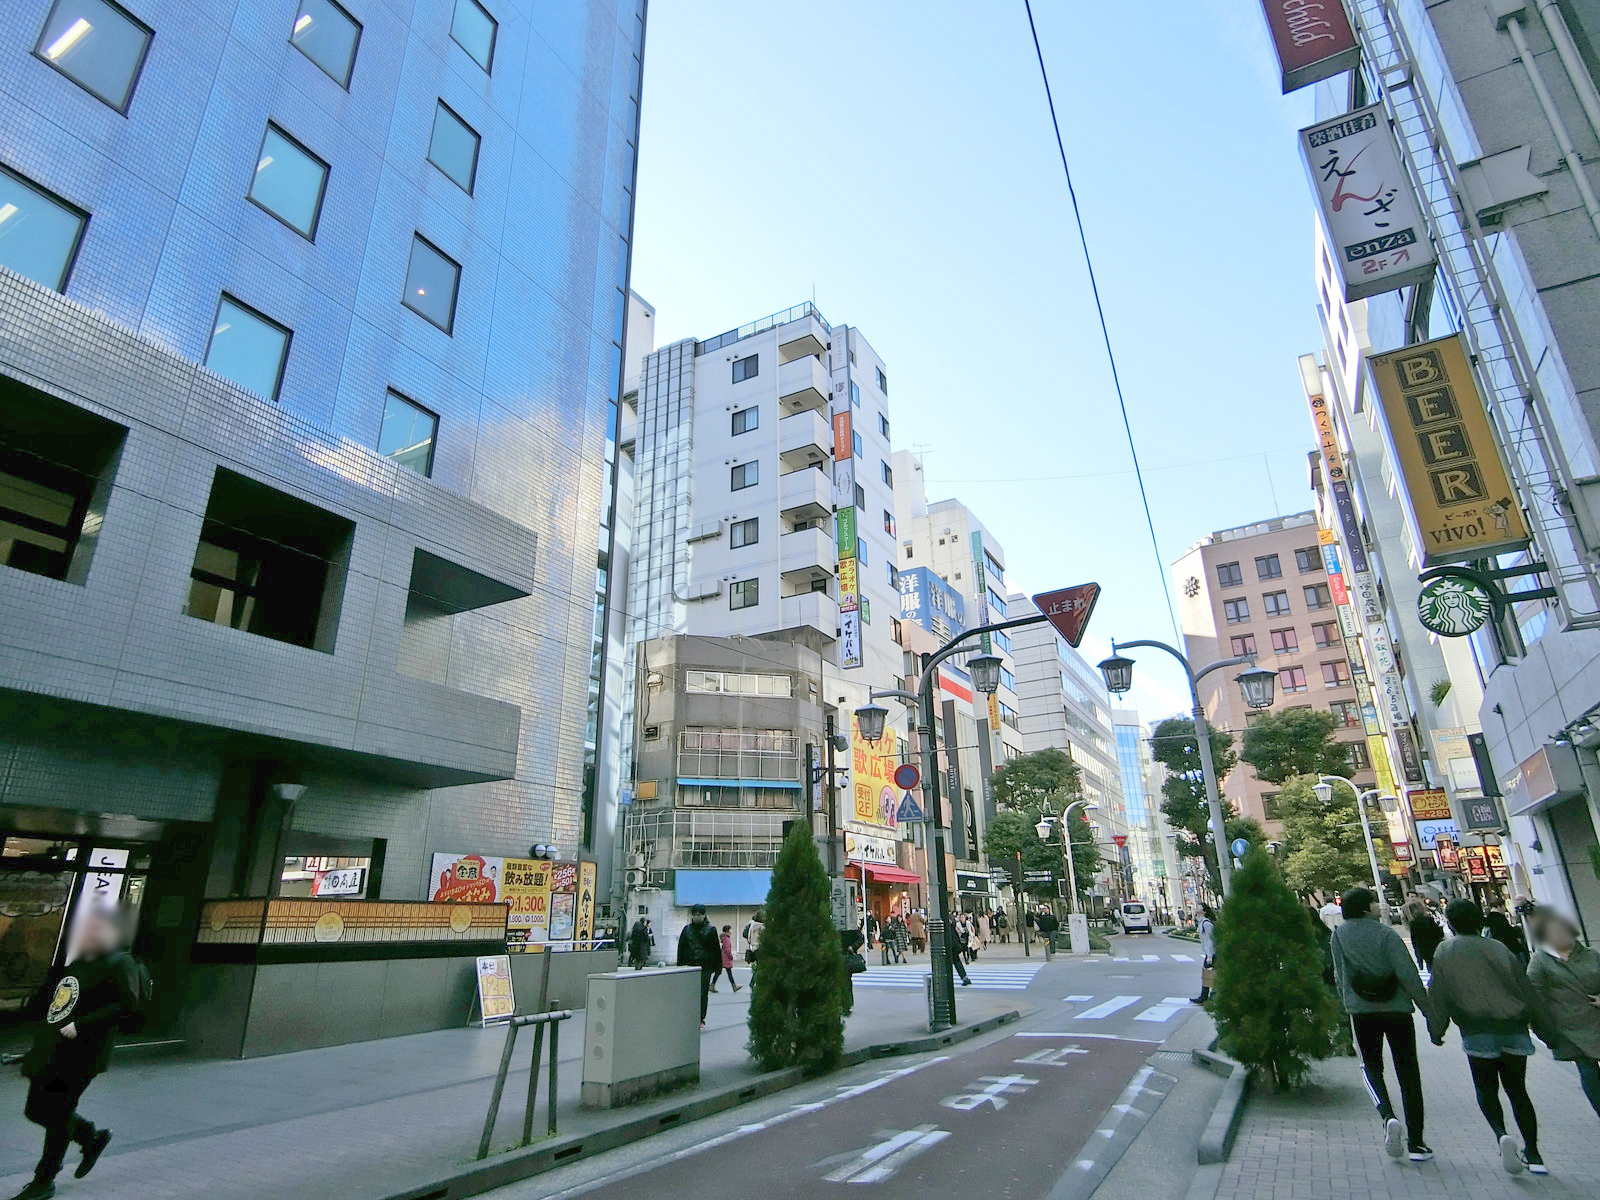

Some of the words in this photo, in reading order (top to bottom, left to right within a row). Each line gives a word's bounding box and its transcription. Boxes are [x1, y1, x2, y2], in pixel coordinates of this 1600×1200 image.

[1349, 231, 1412, 258] enza
[1362, 258, 1387, 275] 2F
[1401, 356, 1477, 501] BEER
[1430, 516, 1486, 545] vivo!
[840, 561, 848, 592] 歌広場
[929, 580, 967, 627] 洋服の
[1048, 596, 1087, 615] 止まれ
[844, 619, 853, 657] イケバル
[854, 747, 895, 784] 歌広場
[857, 786, 870, 801] 受付
[858, 801, 870, 814] 2F
[505, 870, 548, 886] 飲み放題!
